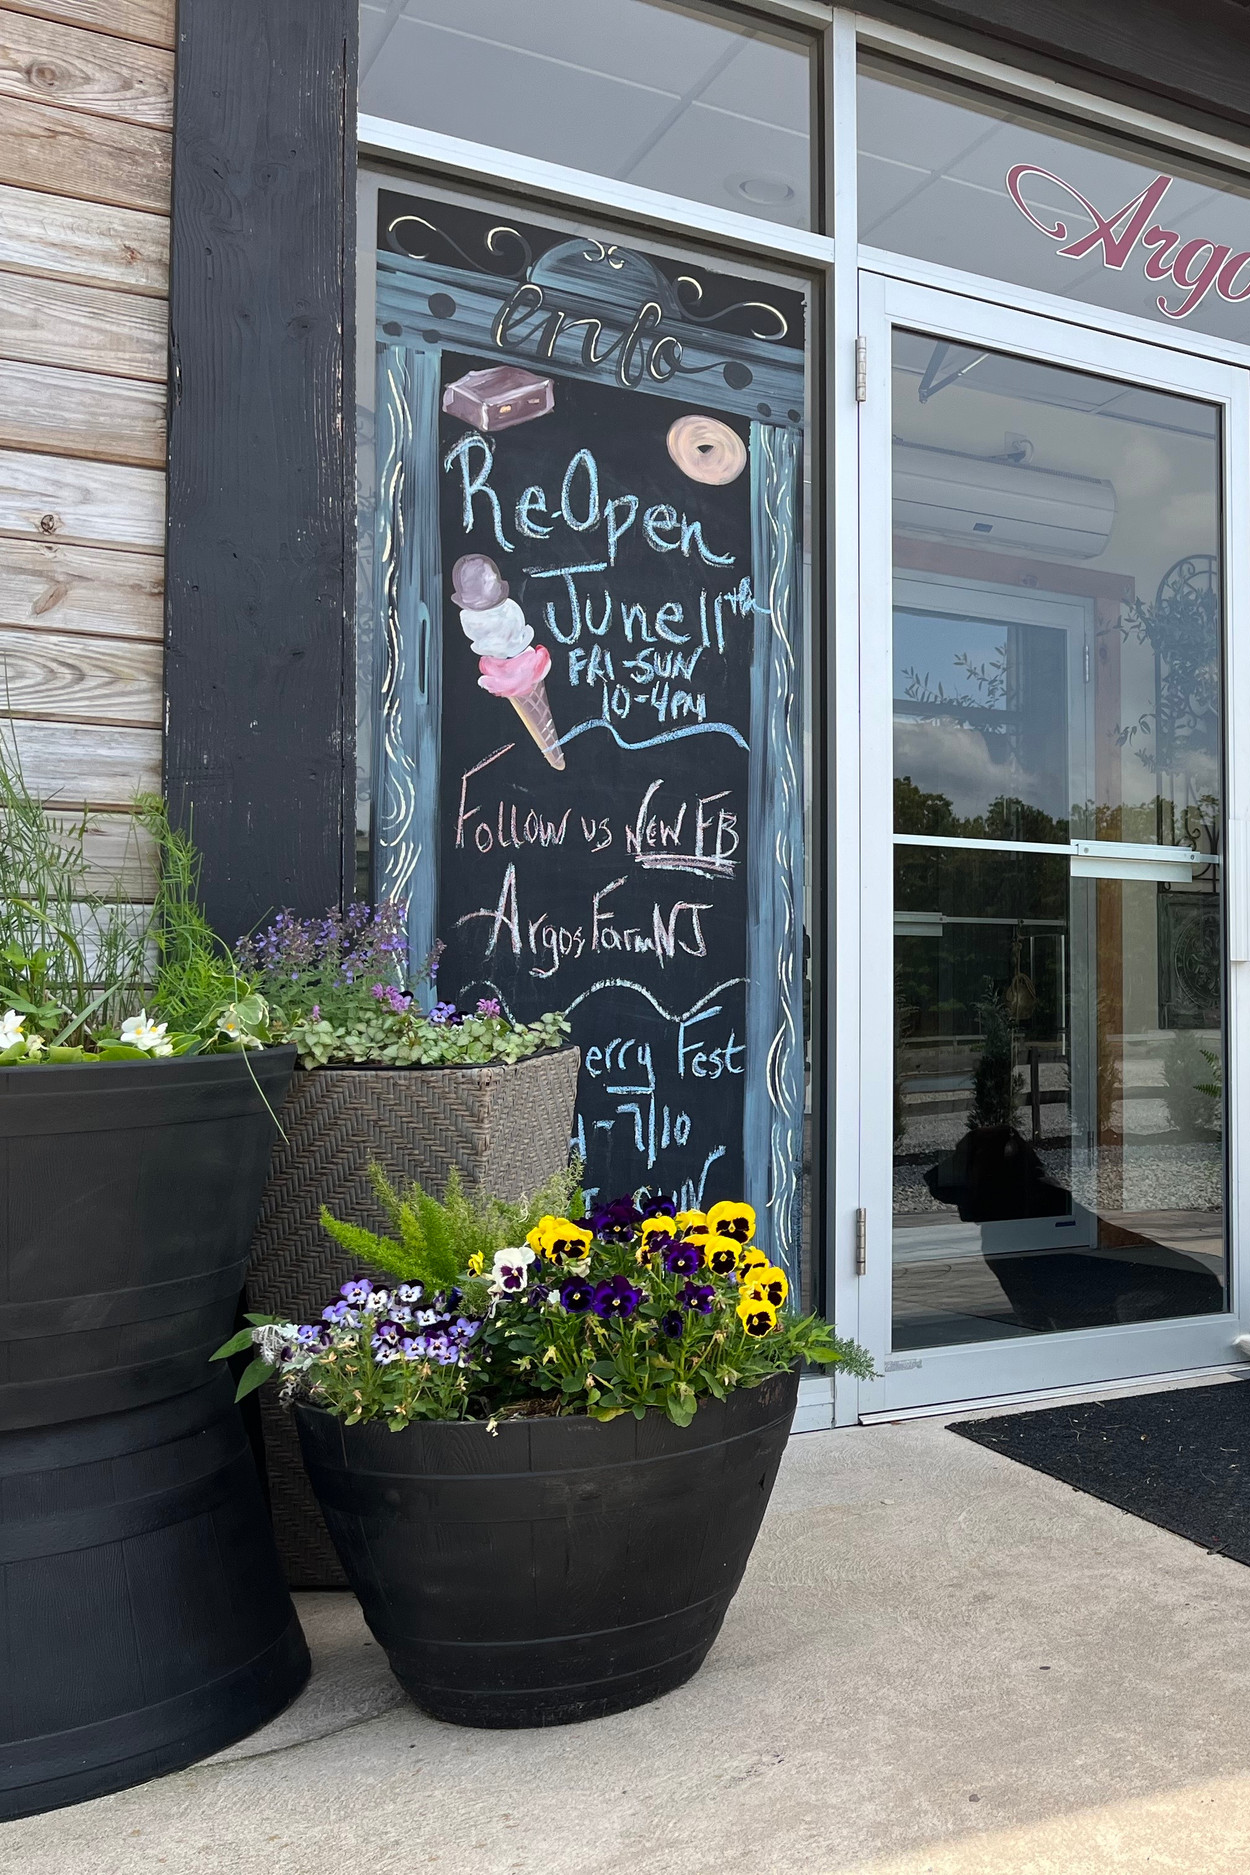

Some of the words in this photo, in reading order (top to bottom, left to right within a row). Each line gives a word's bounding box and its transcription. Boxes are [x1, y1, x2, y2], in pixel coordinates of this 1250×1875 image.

[523, 562, 691, 645] June
[695, 790, 741, 867] FB
[585, 1037, 656, 1095] erry
[678, 1005, 746, 1080] Fest
